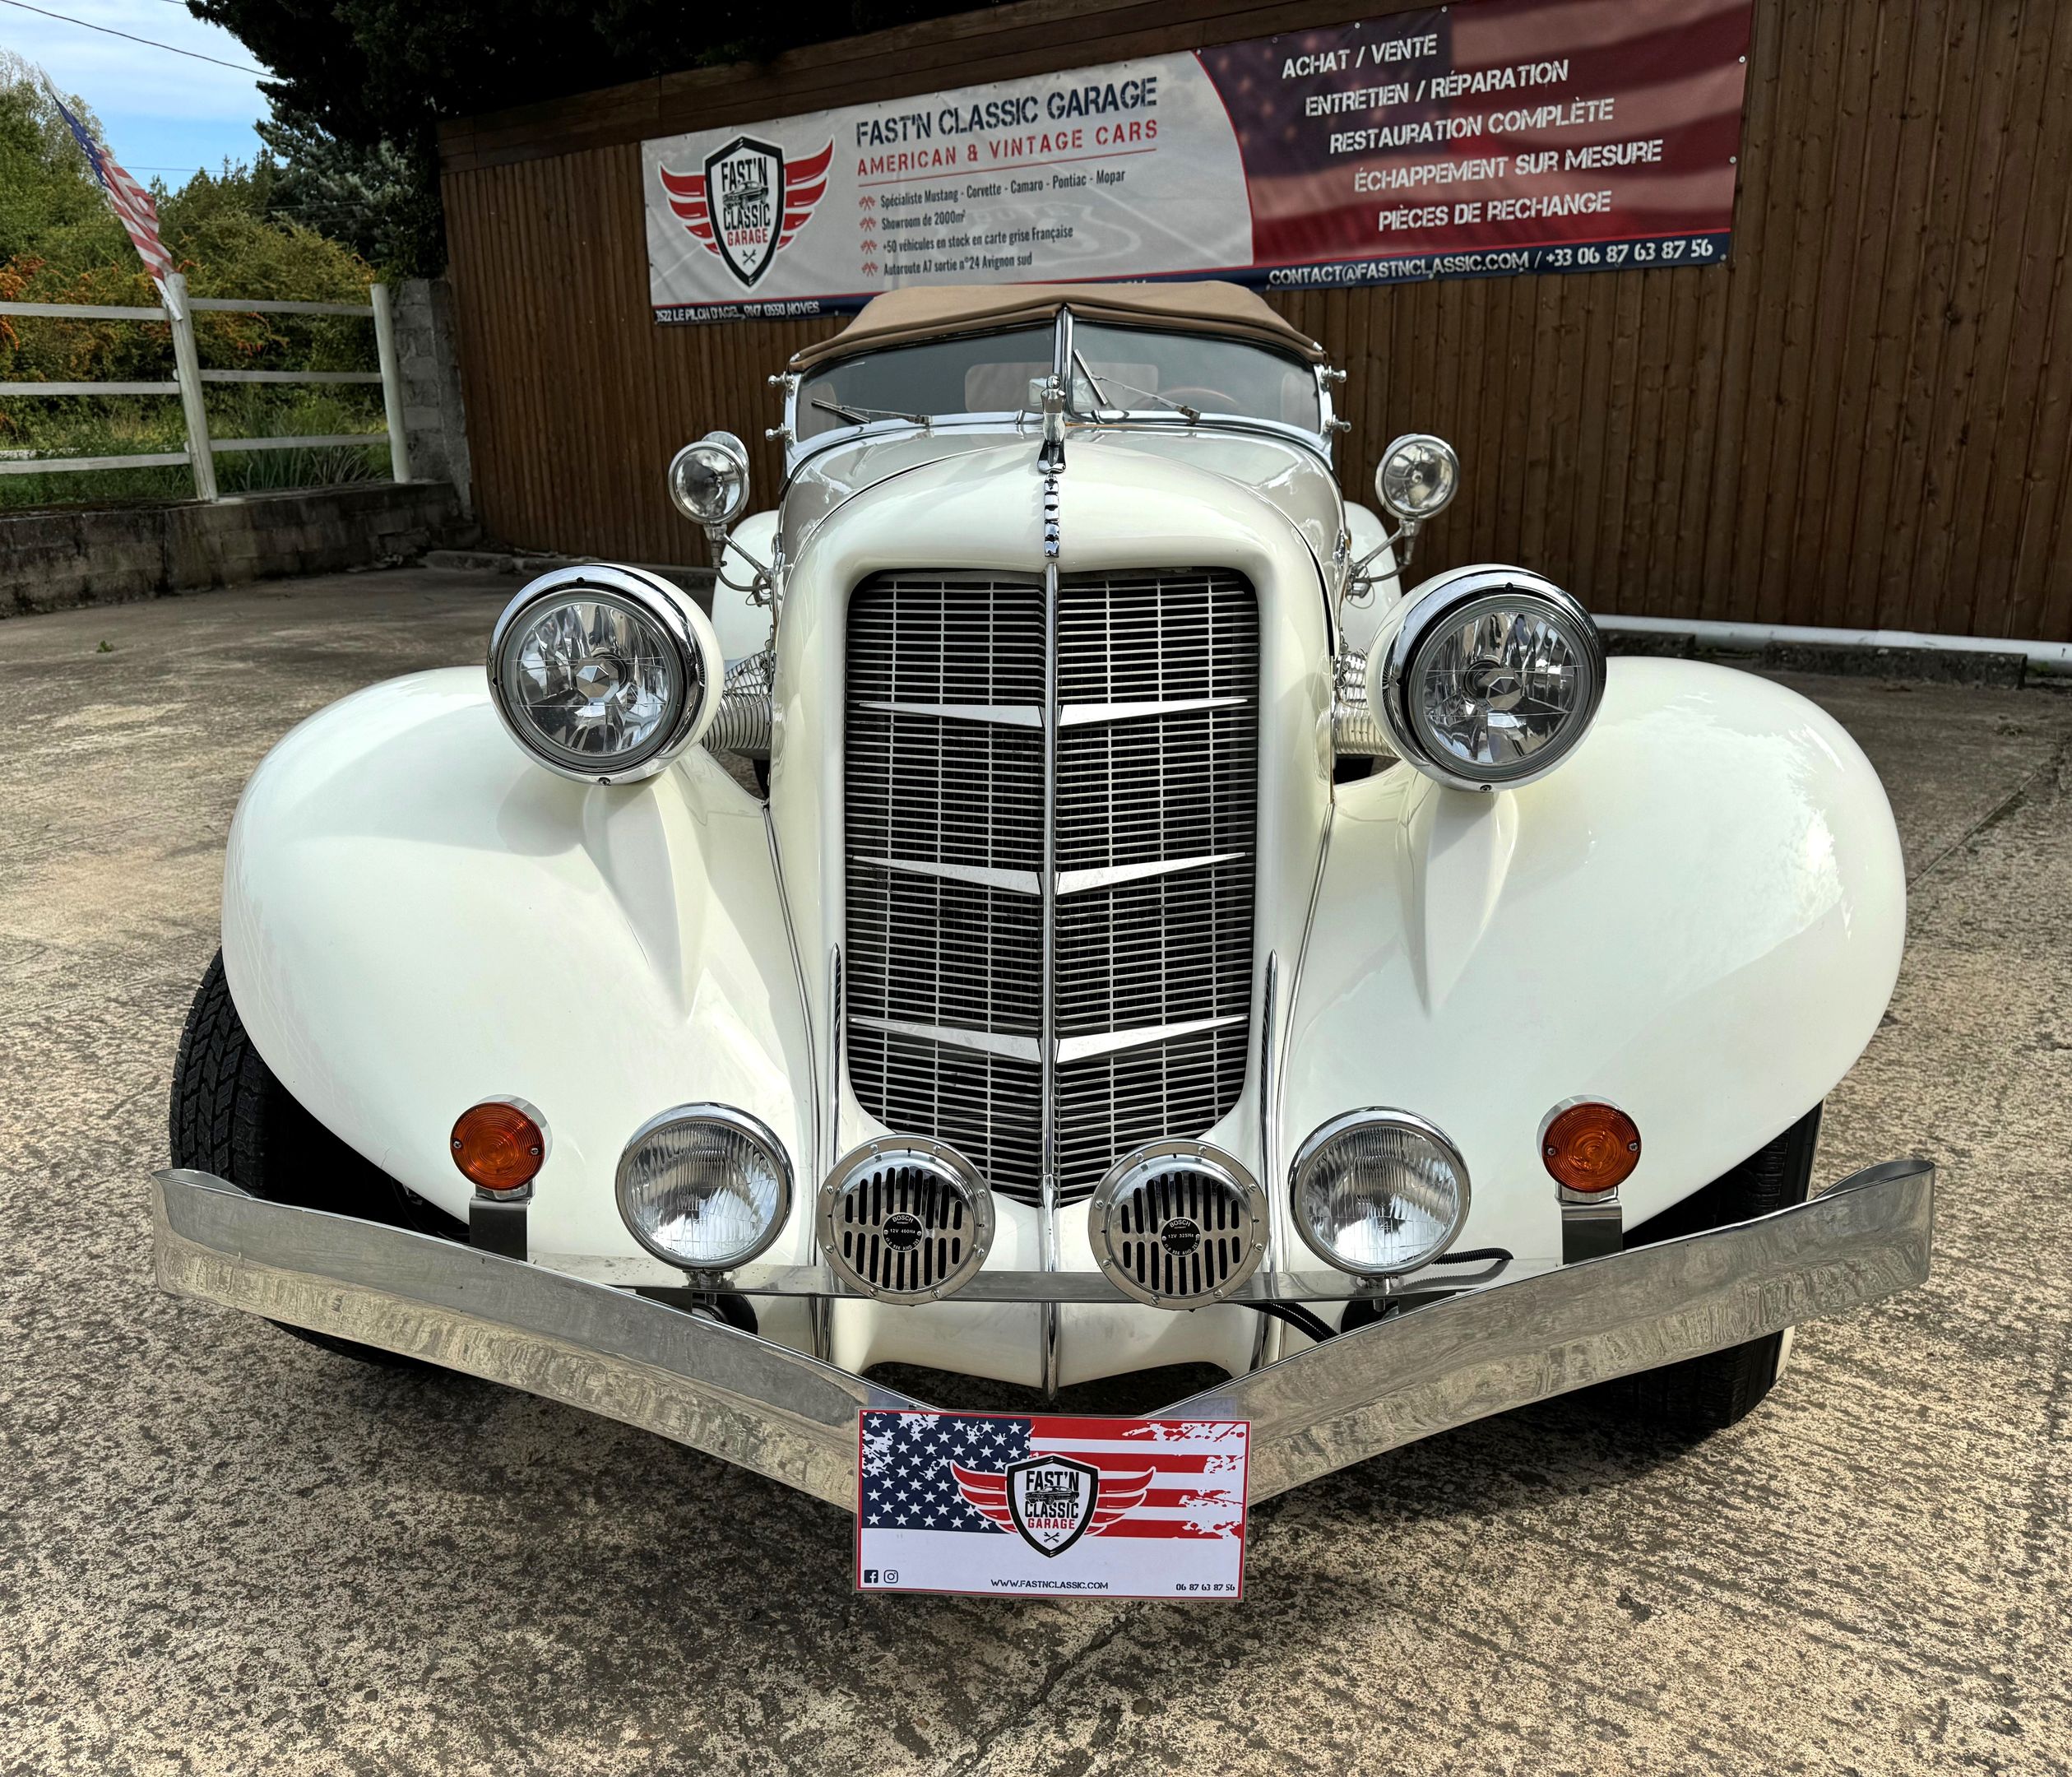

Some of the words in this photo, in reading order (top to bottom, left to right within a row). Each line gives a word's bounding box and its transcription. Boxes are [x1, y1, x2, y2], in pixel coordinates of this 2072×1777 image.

[1282, 49, 1351, 79] ACHAT
[1356, 46, 1365, 68] /
[1371, 34, 1438, 64] VENTE
[1305, 81, 1409, 117] ENTRETIEN
[1415, 80, 1426, 102] /
[1430, 59, 1569, 100] RÉPARATION
[855, 111, 931, 147] FAST'N
[939, 95, 1039, 135] CLASSIC
[1046, 77, 1157, 120] GARAGE
[1330, 115, 1482, 154] RESTAURATION
[1488, 96, 1615, 133] COMPLÈTE
[857, 146, 957, 176] AMERICAN
[967, 144, 978, 161] &
[989, 129, 1082, 159] VINTAGE
[1095, 119, 1157, 146] CARS
[721, 156, 767, 192] FAST'N
[1355, 156, 1509, 193] ÉCHAPPEMENT
[1514, 151, 1559, 175] SUR
[1564, 139, 1663, 170] MESURE
[880, 193, 923, 210] Spécialiste
[925, 189, 958, 202] Mustang
[966, 183, 1001, 198] Corvette
[1011, 179, 1043, 194] Camaro
[1053, 173, 1087, 189] Pontiac
[1096, 169, 1125, 186] Mopar
[724, 203, 771, 230] CLASSIC
[882, 217, 920, 230] Showroom
[922, 213, 932, 227] de
[1379, 204, 1449, 231] PIÈCES
[1454, 202, 1481, 225] DE
[1487, 190, 1612, 221] RECHANGE
[727, 228, 768, 246] GARAGE
[899, 236, 934, 252] véhicules
[936, 239, 945, 248] en
[948, 233, 971, 248] stock
[972, 235, 982, 245] en
[985, 231, 1007, 245] carte
[1008, 229, 1030, 246] grise
[1031, 225, 1073, 243] Française
[884, 262, 920, 276] Autoroute
[923, 259, 932, 272] A7
[934, 258, 957, 271] sortie
[982, 254, 1015, 271] Avignon
[1017, 252, 1032, 266] sud
[1268, 251, 1530, 285] CONTACT@FASTNCLASSIC.COM
[1534, 250, 1542, 269] /
[1546, 249, 1572, 267] +33
[1578, 247, 1601, 265] 06
[1606, 244, 1629, 263] 87
[1634, 243, 1656, 261] 63
[1661, 240, 1686, 259] 87
[1690, 239, 1713, 258] 56
[892, 1214, 914, 1223] BOSCH
[1169, 1219, 1191, 1227] BOSCH
[1026, 1470, 1079, 1492] FAST'N
[1025, 1501, 1079, 1519] CLASSIC
[1027, 1518, 1075, 1529] GARAGE
[990, 1579, 1109, 1589] WWW.FASTNCLASSIC.COM
[1175, 1583, 1187, 1591] 06
